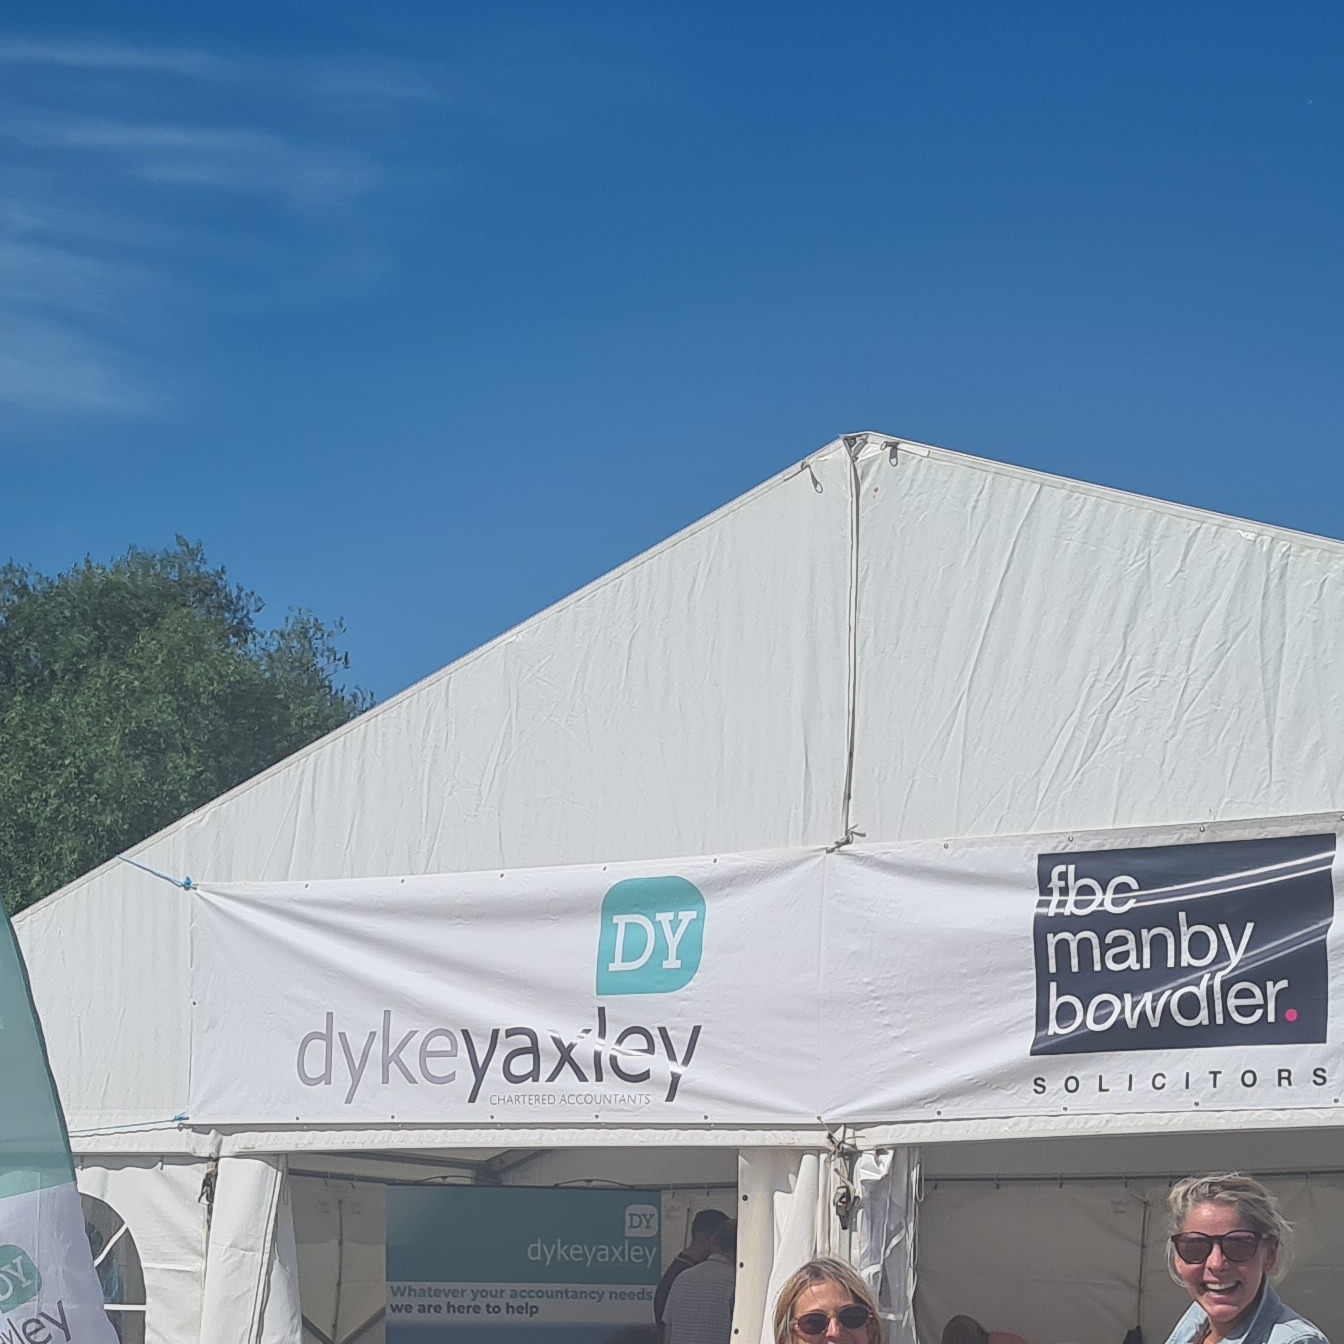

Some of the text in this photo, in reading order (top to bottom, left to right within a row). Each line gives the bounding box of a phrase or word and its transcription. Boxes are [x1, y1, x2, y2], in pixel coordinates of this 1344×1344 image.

[1047, 864, 1140, 917] fbc
[607, 911, 697, 972] DY
[1047, 912, 1255, 976] manby
[296, 1006, 702, 1104] dykeyaxley
[1032, 1067, 1328, 1094] SOLICITORS
[489, 1093, 651, 1105] CHARTERED ACCOUNTANTS
[628, 1213, 655, 1229] DY
[527, 1238, 657, 1268] dykeyaxley
[390, 1285, 467, 1298] Whatever
[470, 1288, 506, 1301] your
[509, 1287, 605, 1302] accountancy
[390, 1302, 539, 1317] we are here to help
